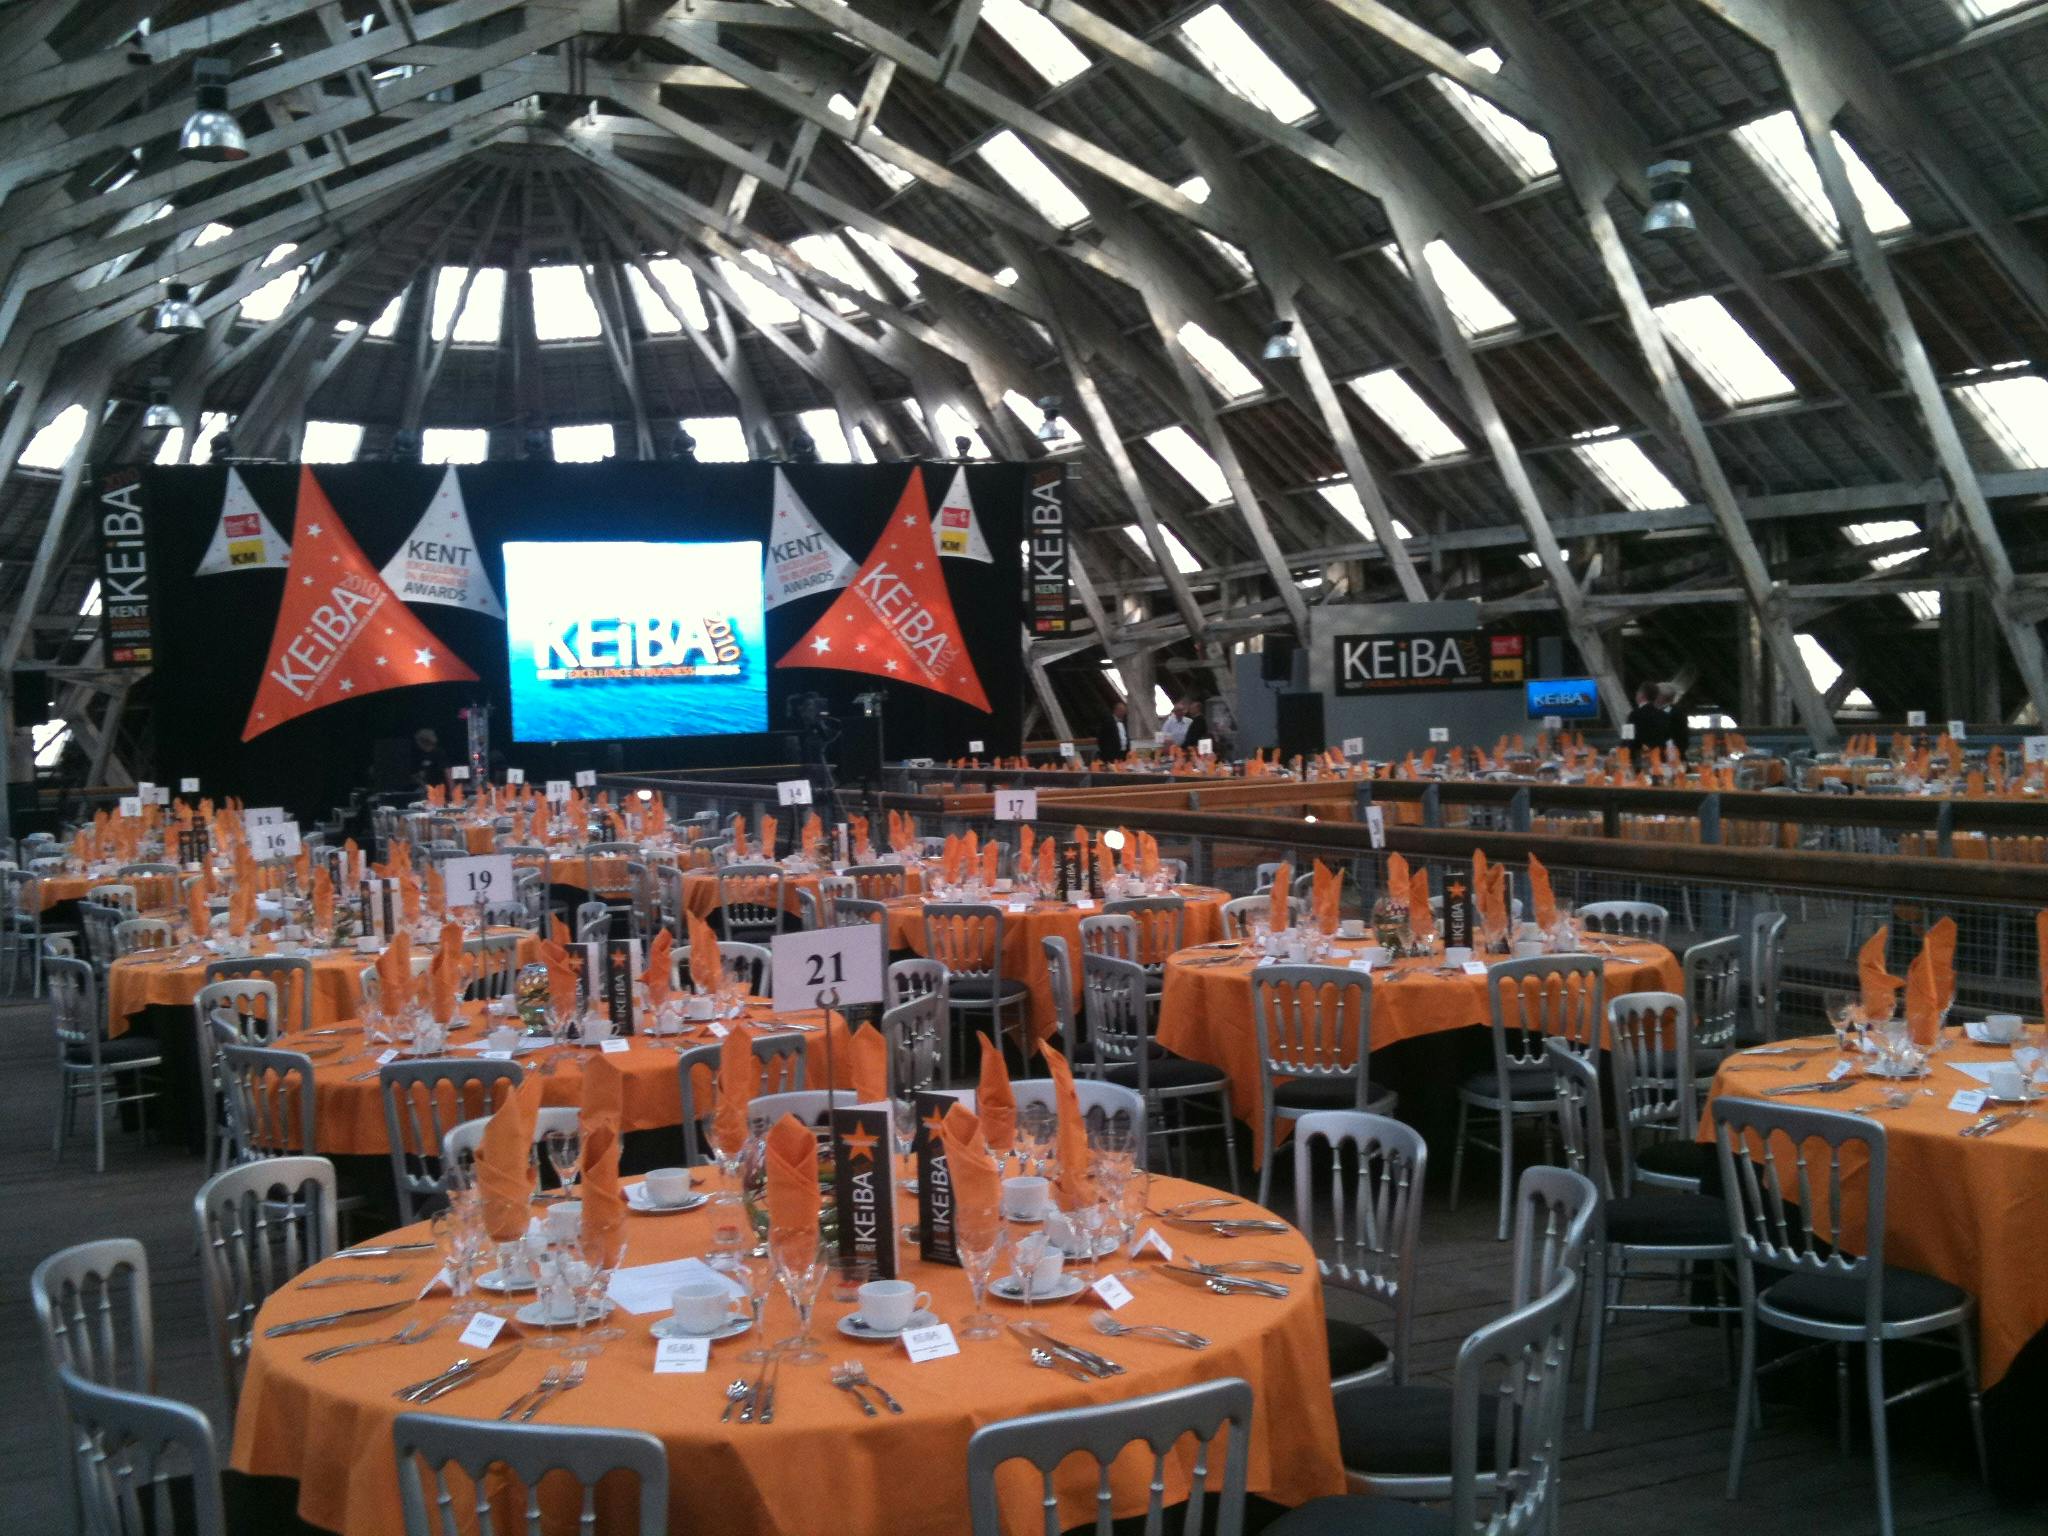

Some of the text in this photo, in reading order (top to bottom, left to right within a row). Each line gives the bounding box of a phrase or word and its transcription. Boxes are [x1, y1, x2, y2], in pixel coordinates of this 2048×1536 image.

[101, 482, 149, 601] KEiBA
[1032, 480, 1064, 580] KEiBA
[230, 551, 258, 565] KM
[407, 540, 472, 566] KENT
[771, 532, 823, 564] KENT
[403, 582, 468, 601] AWARDS
[783, 570, 834, 595] AWARDS
[109, 605, 149, 617] KENT
[860, 562, 948, 667] KEiBA
[271, 587, 373, 697] KEiBA
[534, 612, 742, 669] KEiBA 2010
[1343, 637, 1467, 680] KEiBA
[1008, 799, 1025, 812] 17
[267, 833, 286, 849] 16
[467, 870, 493, 891] 19
[804, 951, 848, 986] 21
[930, 1155, 951, 1224] KEiBA
[852, 1171, 877, 1242] KEiBA
